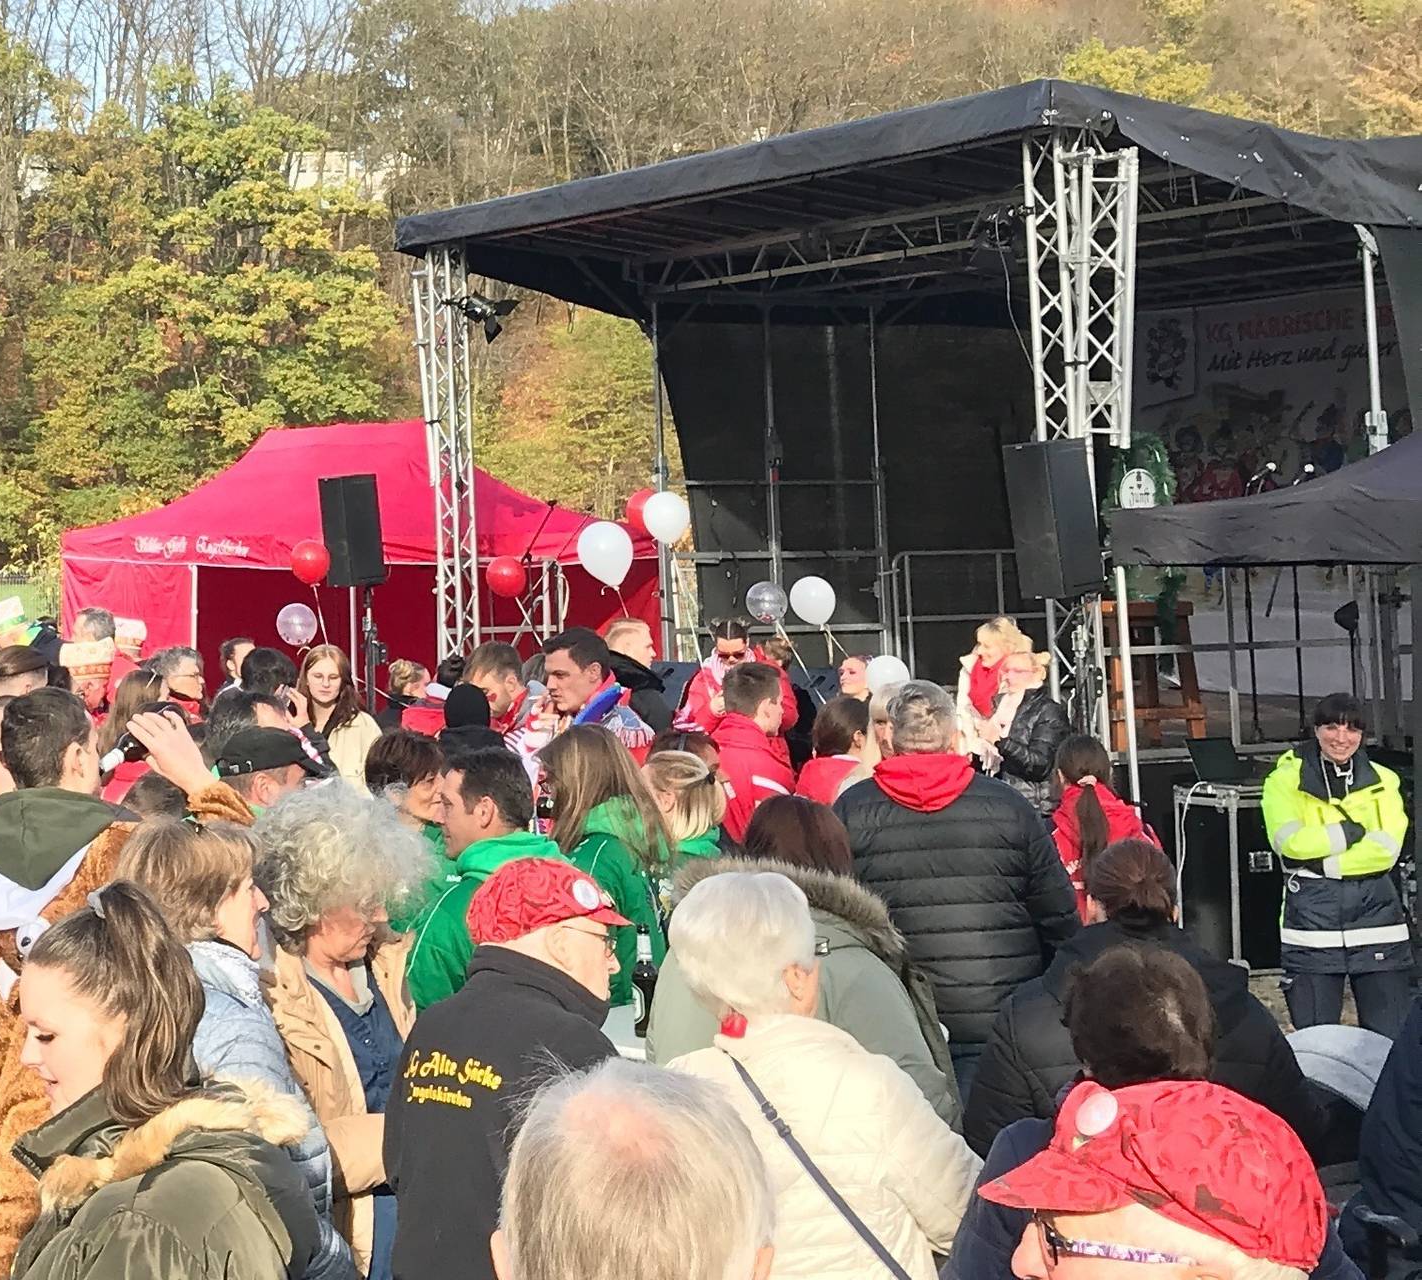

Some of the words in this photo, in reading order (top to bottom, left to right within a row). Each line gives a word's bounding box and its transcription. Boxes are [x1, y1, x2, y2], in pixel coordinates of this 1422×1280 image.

[1207, 349, 1241, 372] Mit
[1246, 346, 1293, 369] Herz
[1298, 337, 1336, 363] und
[1336, 341, 1399, 373] guer
[419, 1051, 458, 1078] Alte
